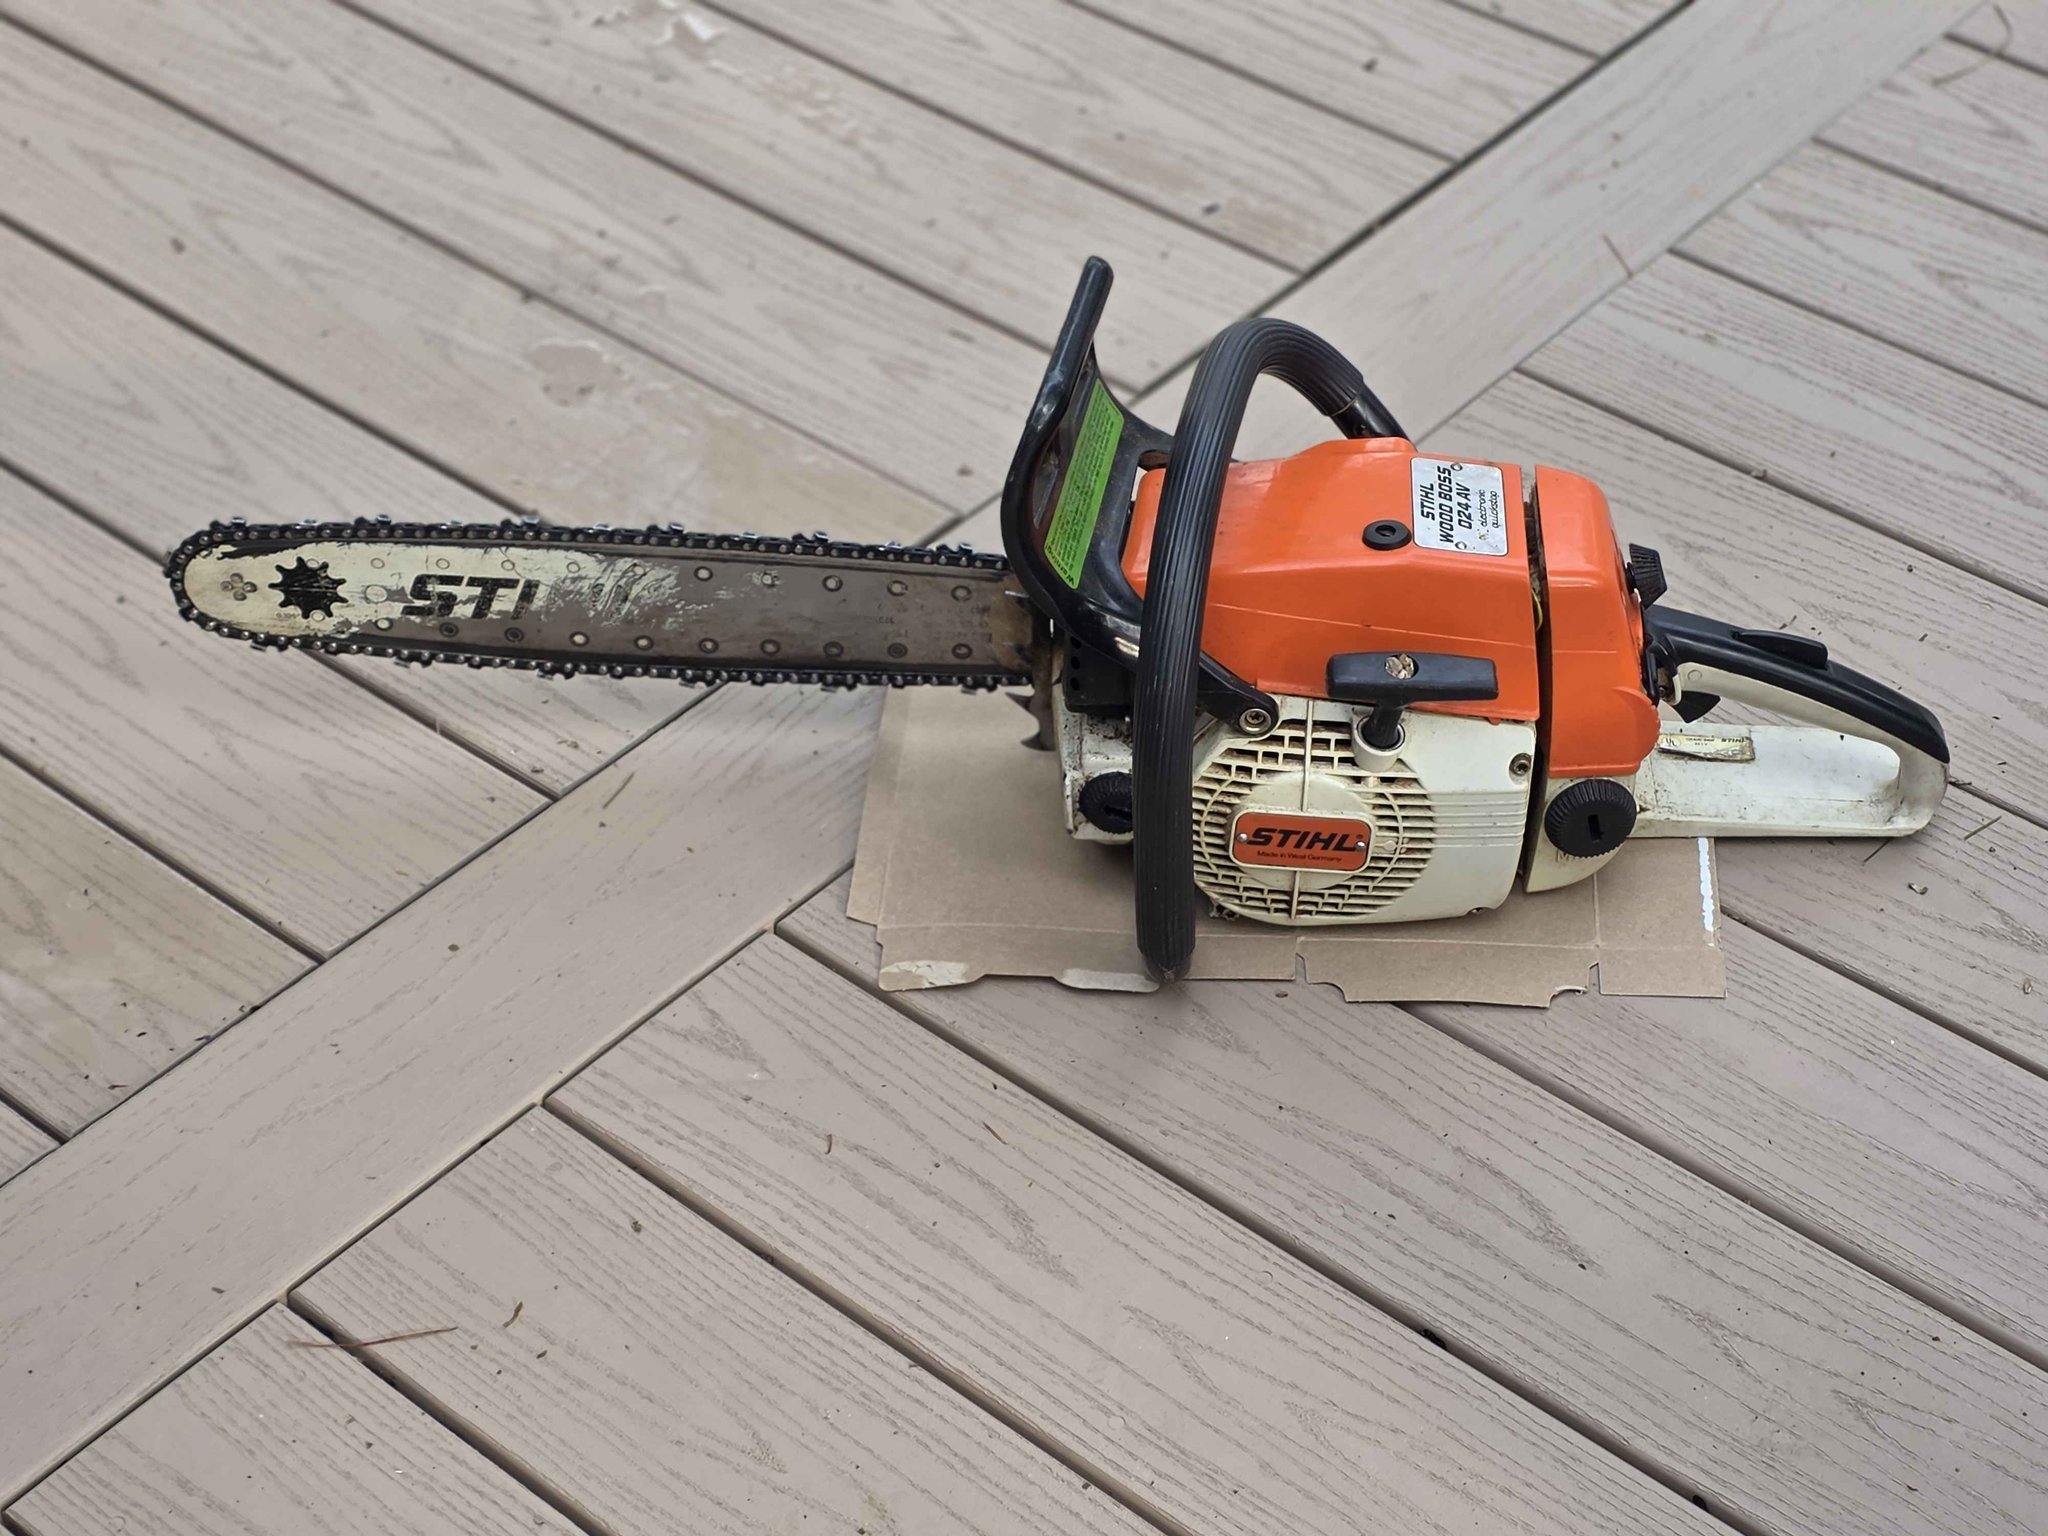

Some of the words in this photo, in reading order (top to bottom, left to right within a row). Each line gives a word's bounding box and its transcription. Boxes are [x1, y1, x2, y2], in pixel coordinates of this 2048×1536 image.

[1437, 466, 1453, 502] BOSS
[1455, 482, 1471, 502] AV
[1420, 483, 1435, 521] STIHL
[1457, 502, 1473, 530] 024
[1477, 489, 1488, 528] electronic
[1439, 504, 1454, 544] WOOD
[1247, 827, 1357, 852] STIHL
[1257, 850, 1278, 858] Made
[1308, 854, 1343, 863] Germany
